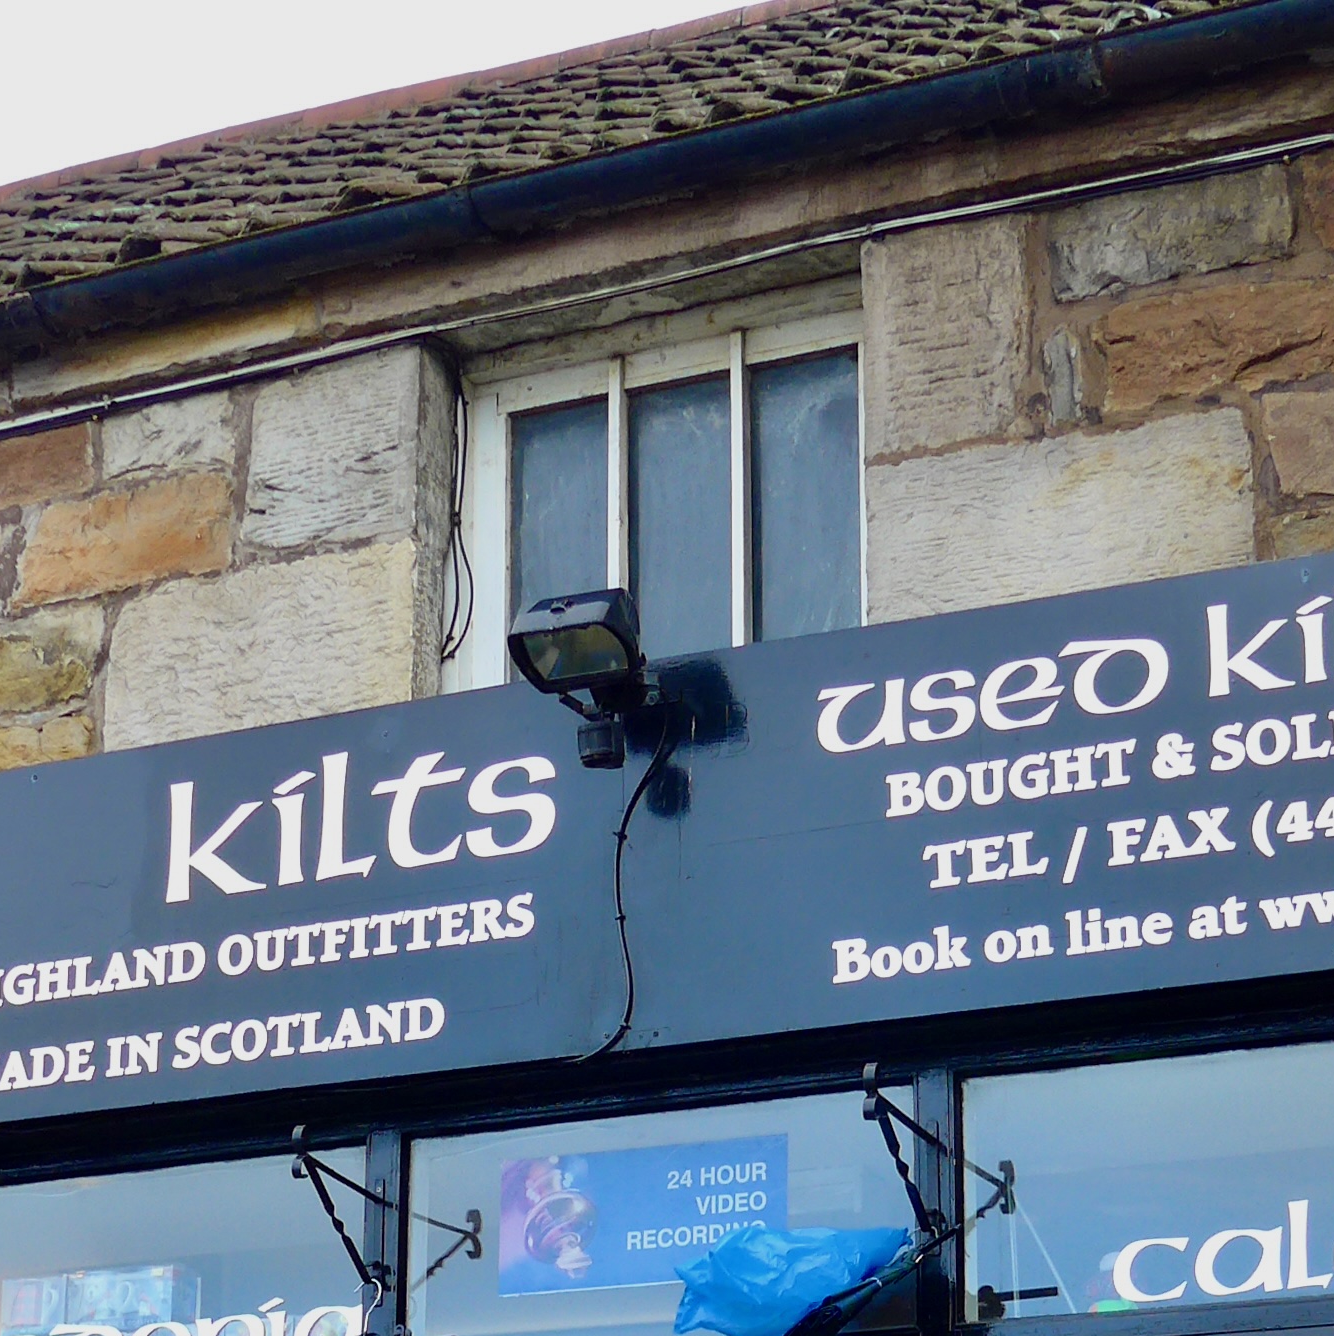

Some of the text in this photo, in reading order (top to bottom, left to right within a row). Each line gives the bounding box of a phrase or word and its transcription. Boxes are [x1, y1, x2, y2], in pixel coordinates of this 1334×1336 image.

[885, 739, 1136, 817] BOUGHT
[1151, 732, 1196, 779] &
[922, 831, 1049, 889] TEL
[1062, 827, 1088, 884] /
[1107, 806, 1236, 866] FAX
[217, 891, 535, 976] OUTFITTERS
[831, 925, 971, 984] Book
[983, 923, 1055, 963] on
[1065, 907, 1173, 956] line
[1188, 896, 1248, 939] at
[106, 1032, 163, 1078] IN
[172, 997, 445, 1069] SCOTLAND
[667, 1161, 767, 1190] 24 HOUR
[696, 1190, 767, 1216] VIDEO
[627, 1220, 766, 1251] RECORD
